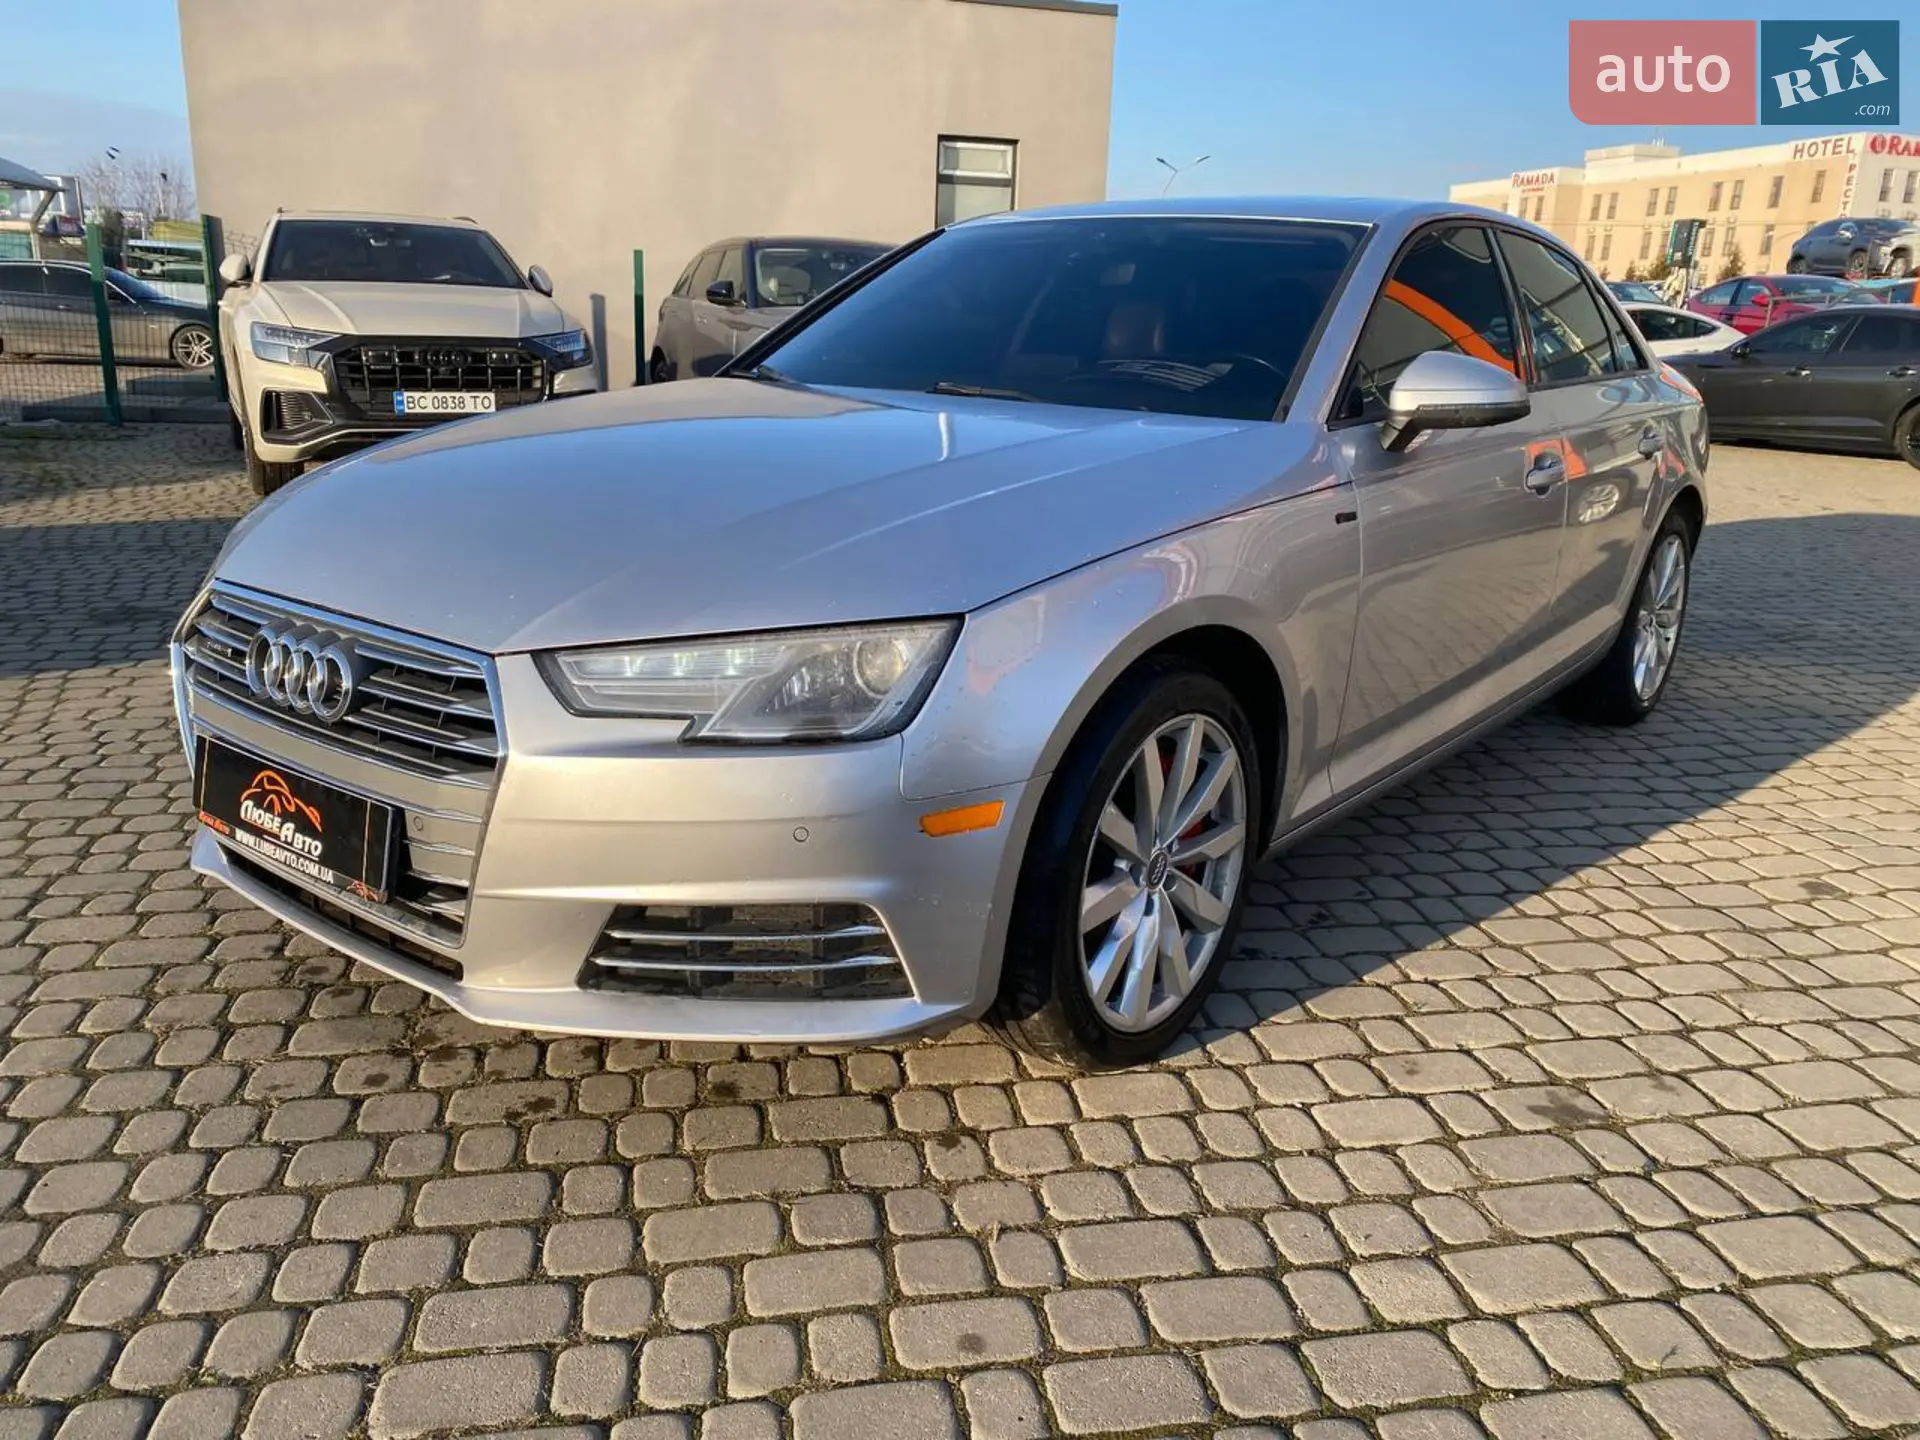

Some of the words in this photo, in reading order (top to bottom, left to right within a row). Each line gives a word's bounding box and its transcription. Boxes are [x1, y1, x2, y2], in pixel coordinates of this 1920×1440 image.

[1792, 136, 1856, 160] HOTEL
[1511, 171, 1555, 188] RAMADA
[406, 395, 428, 410] BC
[431, 395, 466, 410] 0838
[470, 395, 492, 410] TO
